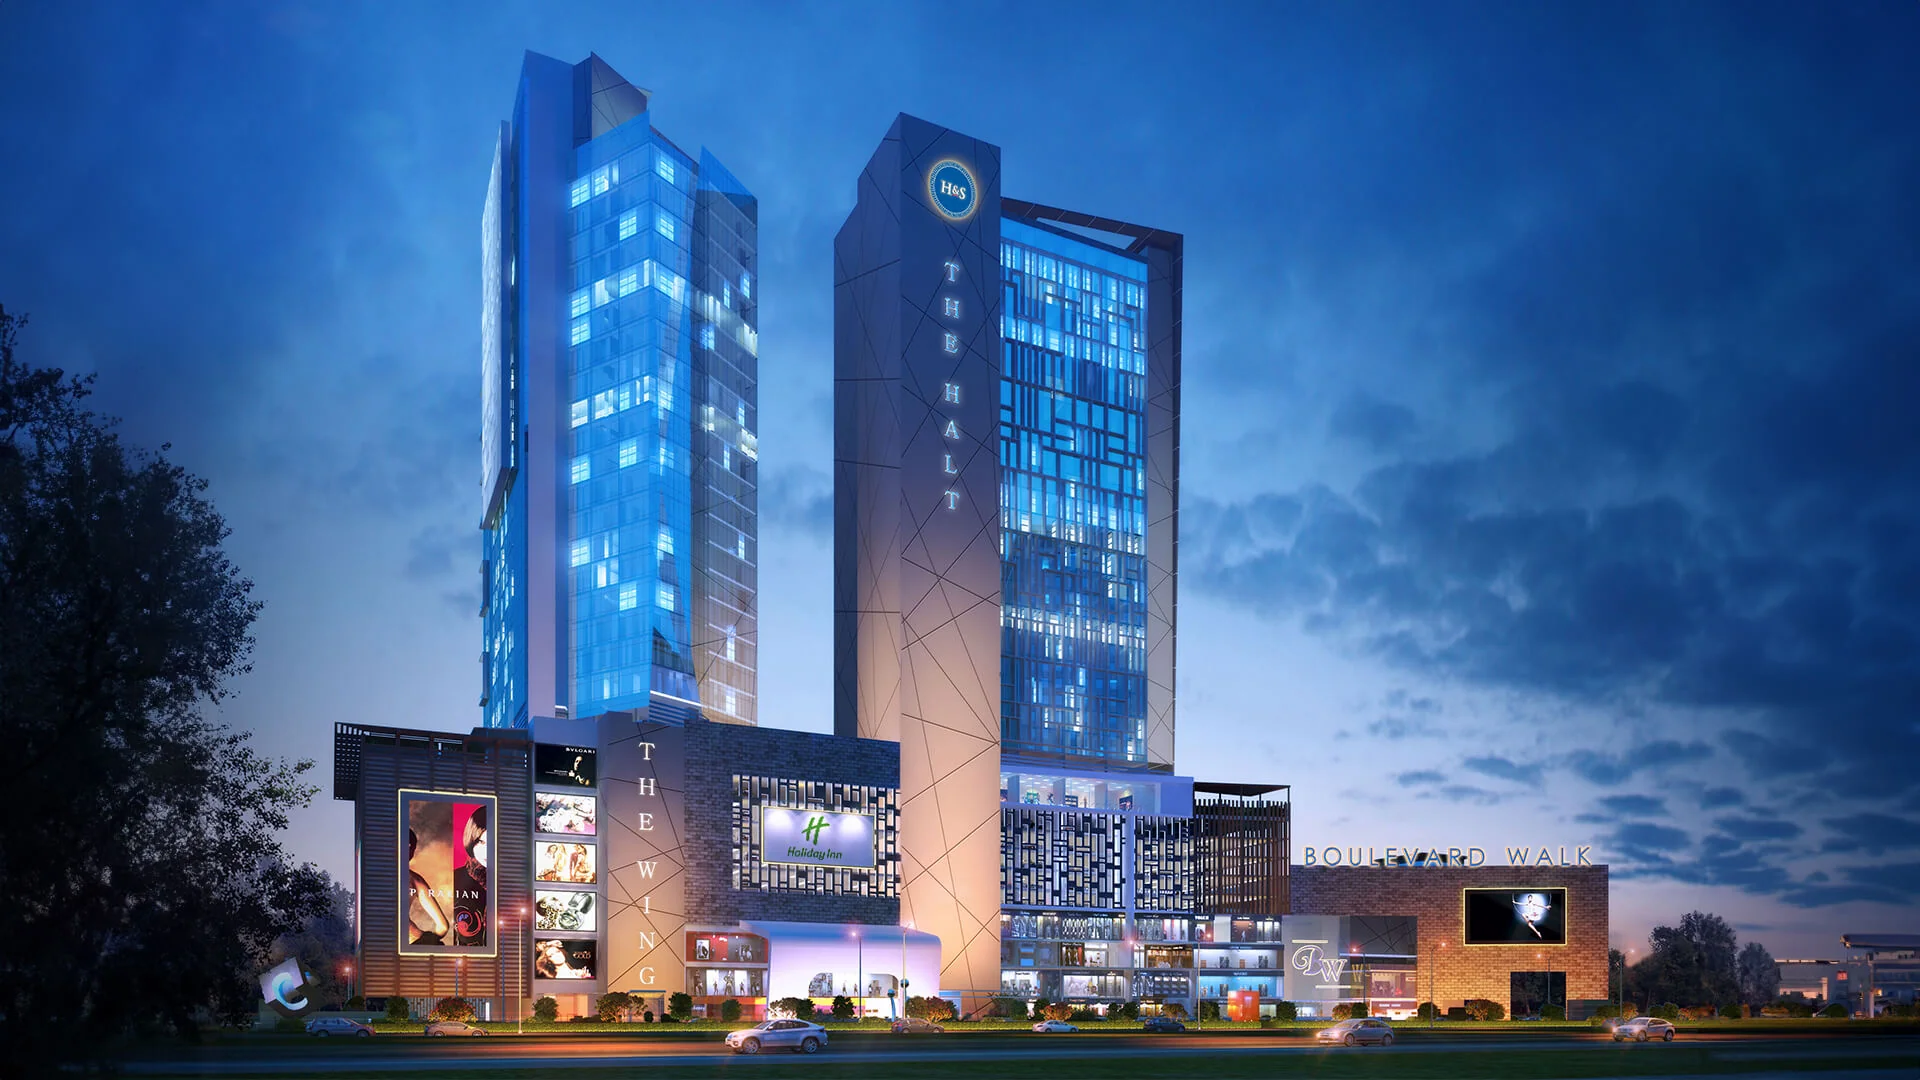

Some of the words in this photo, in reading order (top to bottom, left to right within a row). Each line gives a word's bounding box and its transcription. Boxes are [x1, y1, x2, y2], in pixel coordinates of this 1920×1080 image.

[941, 179, 967, 200] H&S
[943, 261, 960, 354] THE
[944, 382, 960, 510] HALT
[638, 742, 656, 831] THE
[787, 846, 826, 860] Holiday
[827, 848, 843, 859] Inn
[1303, 845, 1486, 868] BOULEVARD
[1506, 845, 1593, 868] WALK
[636, 860, 658, 985] WING
